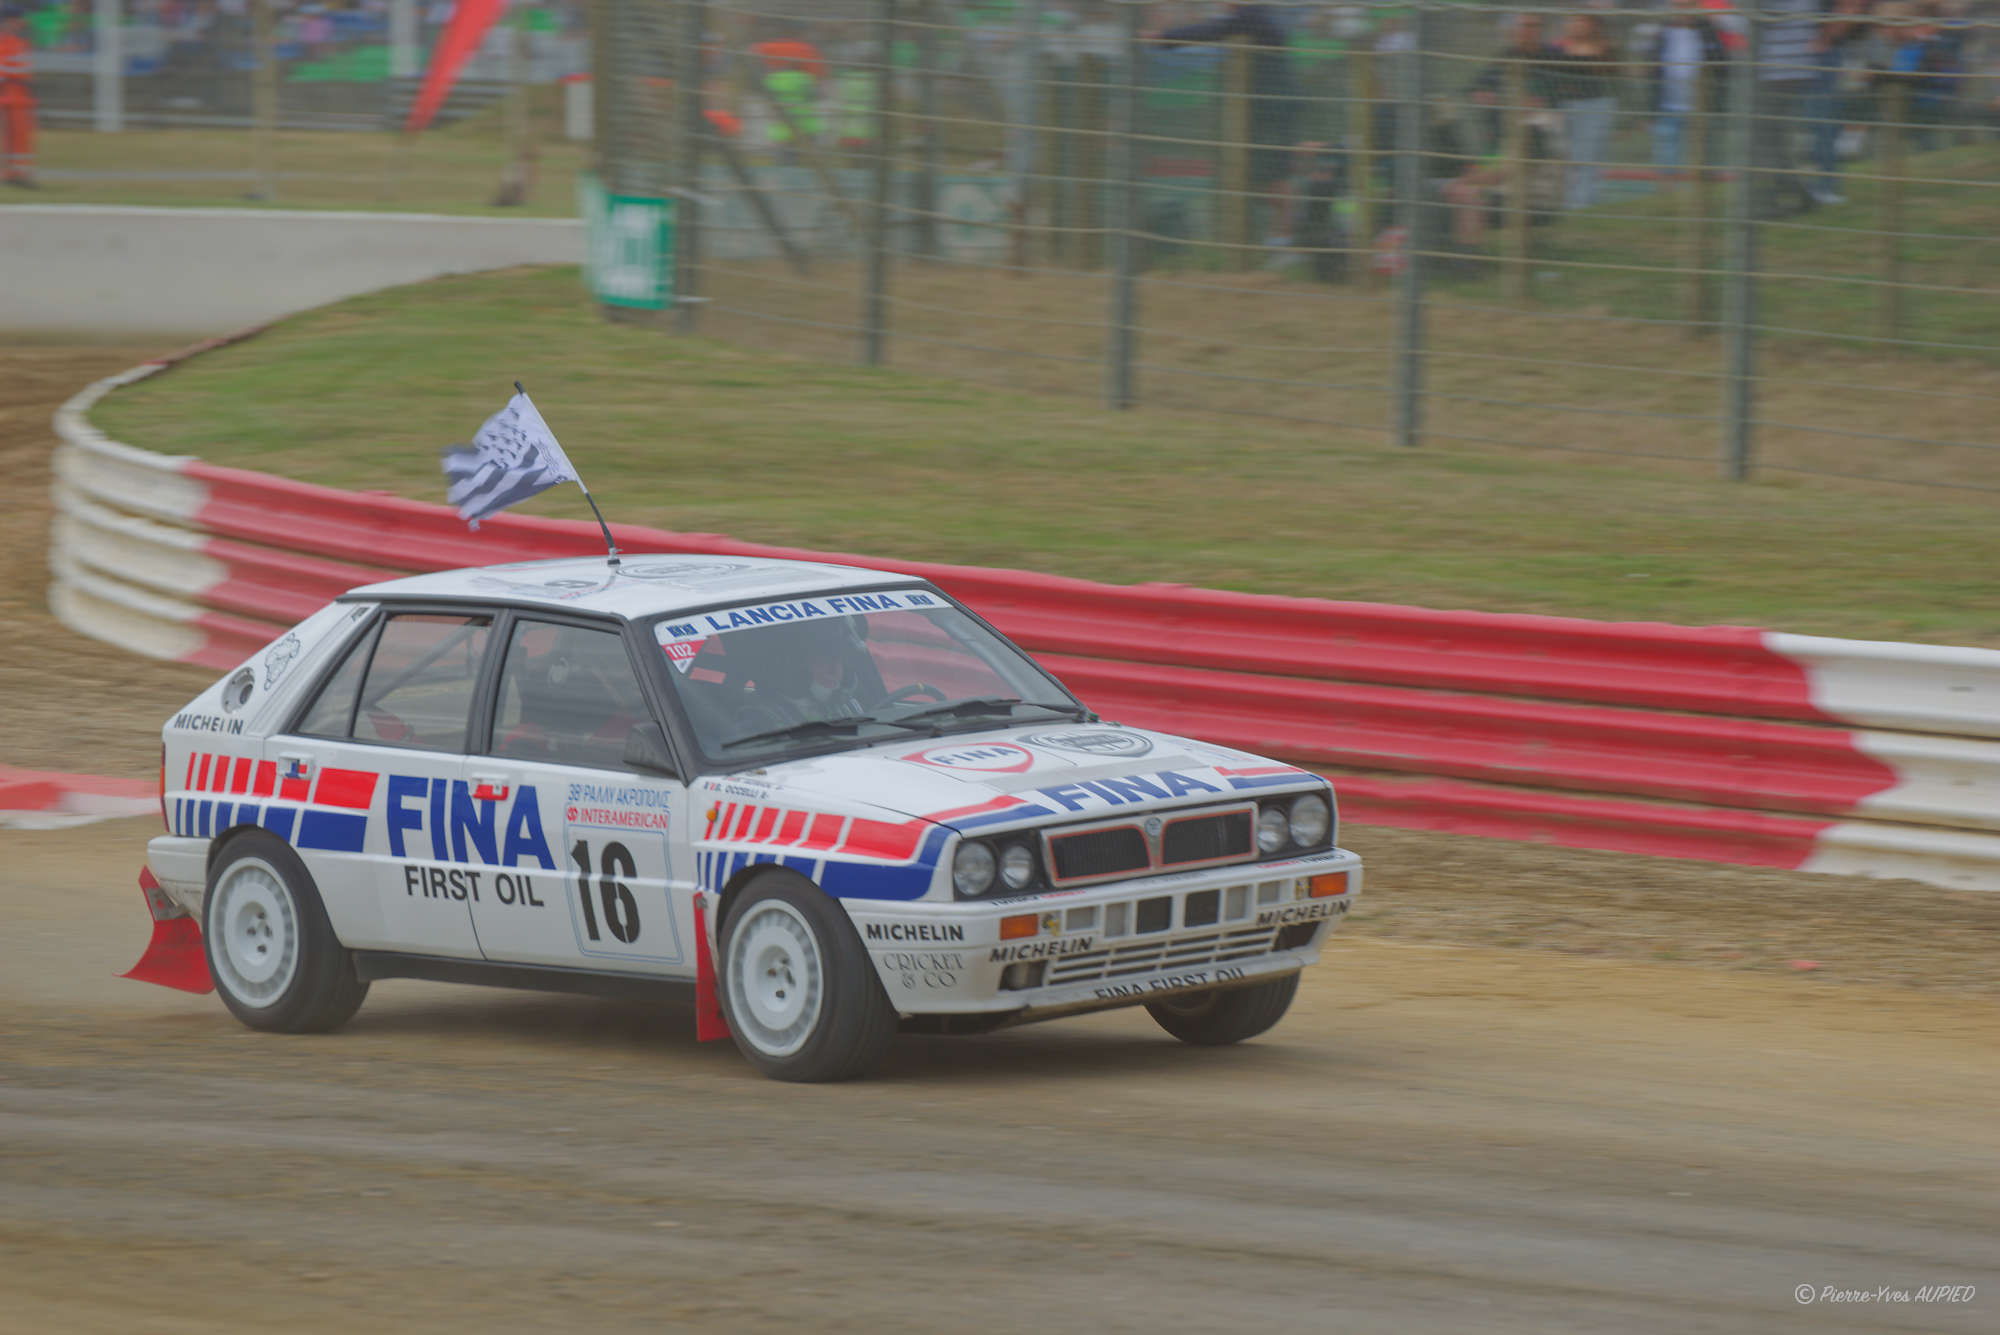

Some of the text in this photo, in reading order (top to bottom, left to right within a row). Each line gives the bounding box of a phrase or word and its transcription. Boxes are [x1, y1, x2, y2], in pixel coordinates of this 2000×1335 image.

[705, 602, 826, 631] LANCIA
[827, 594, 903, 615] FINA
[666, 643, 696, 660] 102
[932, 747, 1020, 765] FINA
[1037, 770, 1222, 813] FINA
[387, 774, 557, 870] FINA
[581, 807, 667, 829] INTERAMERICAN
[404, 865, 545, 907] FIRST OIL
[571, 839, 641, 944] 16
[1256, 899, 1351, 927] MICHELIN
[866, 923, 965, 941] MICHELIN
[883, 953, 965, 971] CRICKET
[989, 937, 1093, 962] MICHELIN
[923, 971, 957, 989] CO
[1093, 983, 1145, 1001] FINA
[1150, 972, 1210, 992] FIRST
